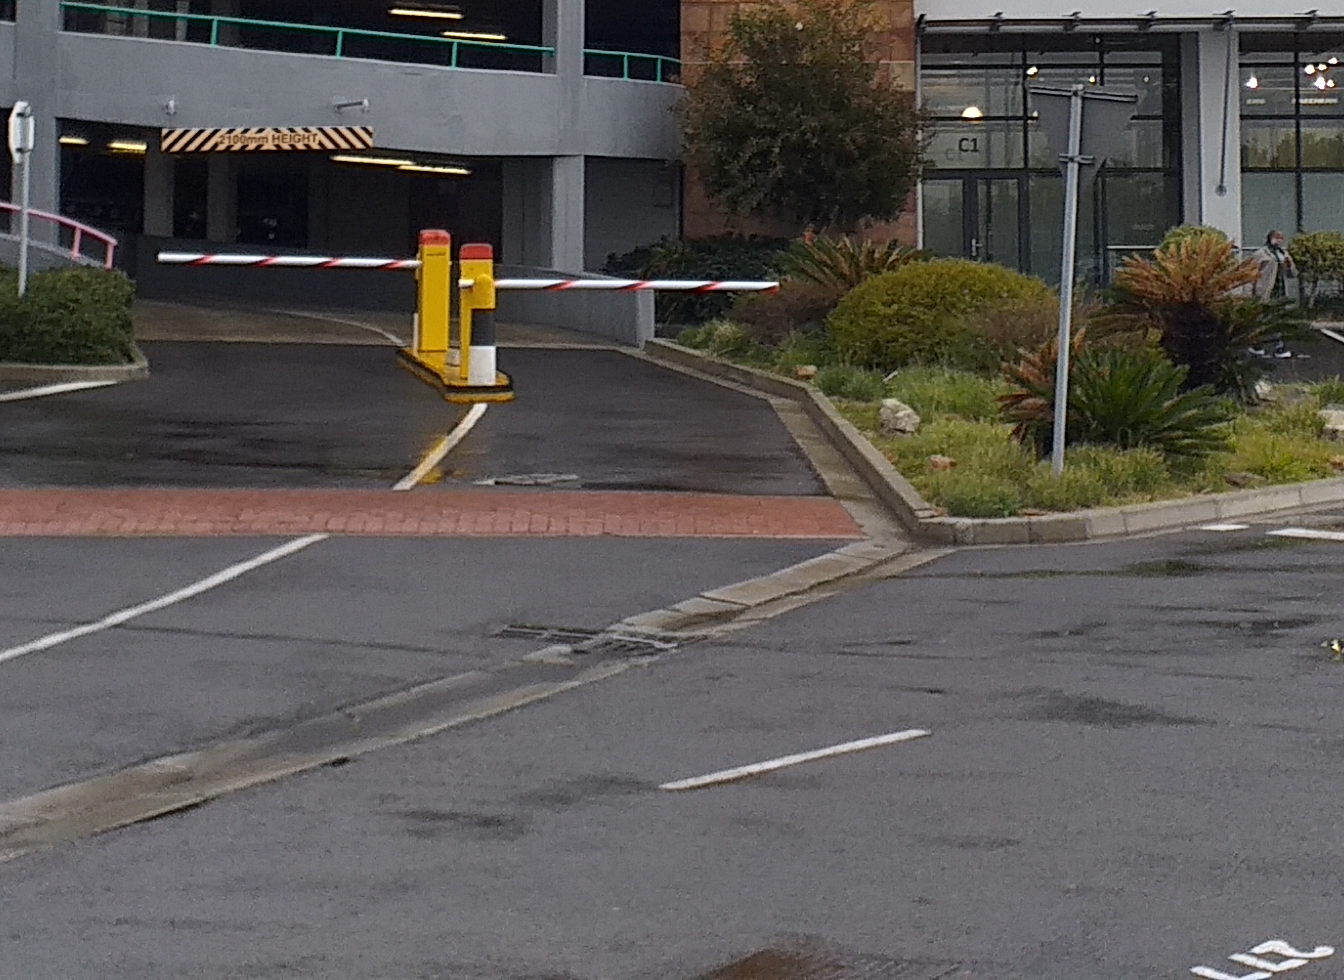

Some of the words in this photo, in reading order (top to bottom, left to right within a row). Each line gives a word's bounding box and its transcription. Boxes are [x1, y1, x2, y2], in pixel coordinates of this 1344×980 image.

[219, 134, 268, 145] 2100mm
[272, 133, 318, 144] HEIGHT
[958, 137, 979, 153] C1
[1189, 940, 1335, 980] 277
